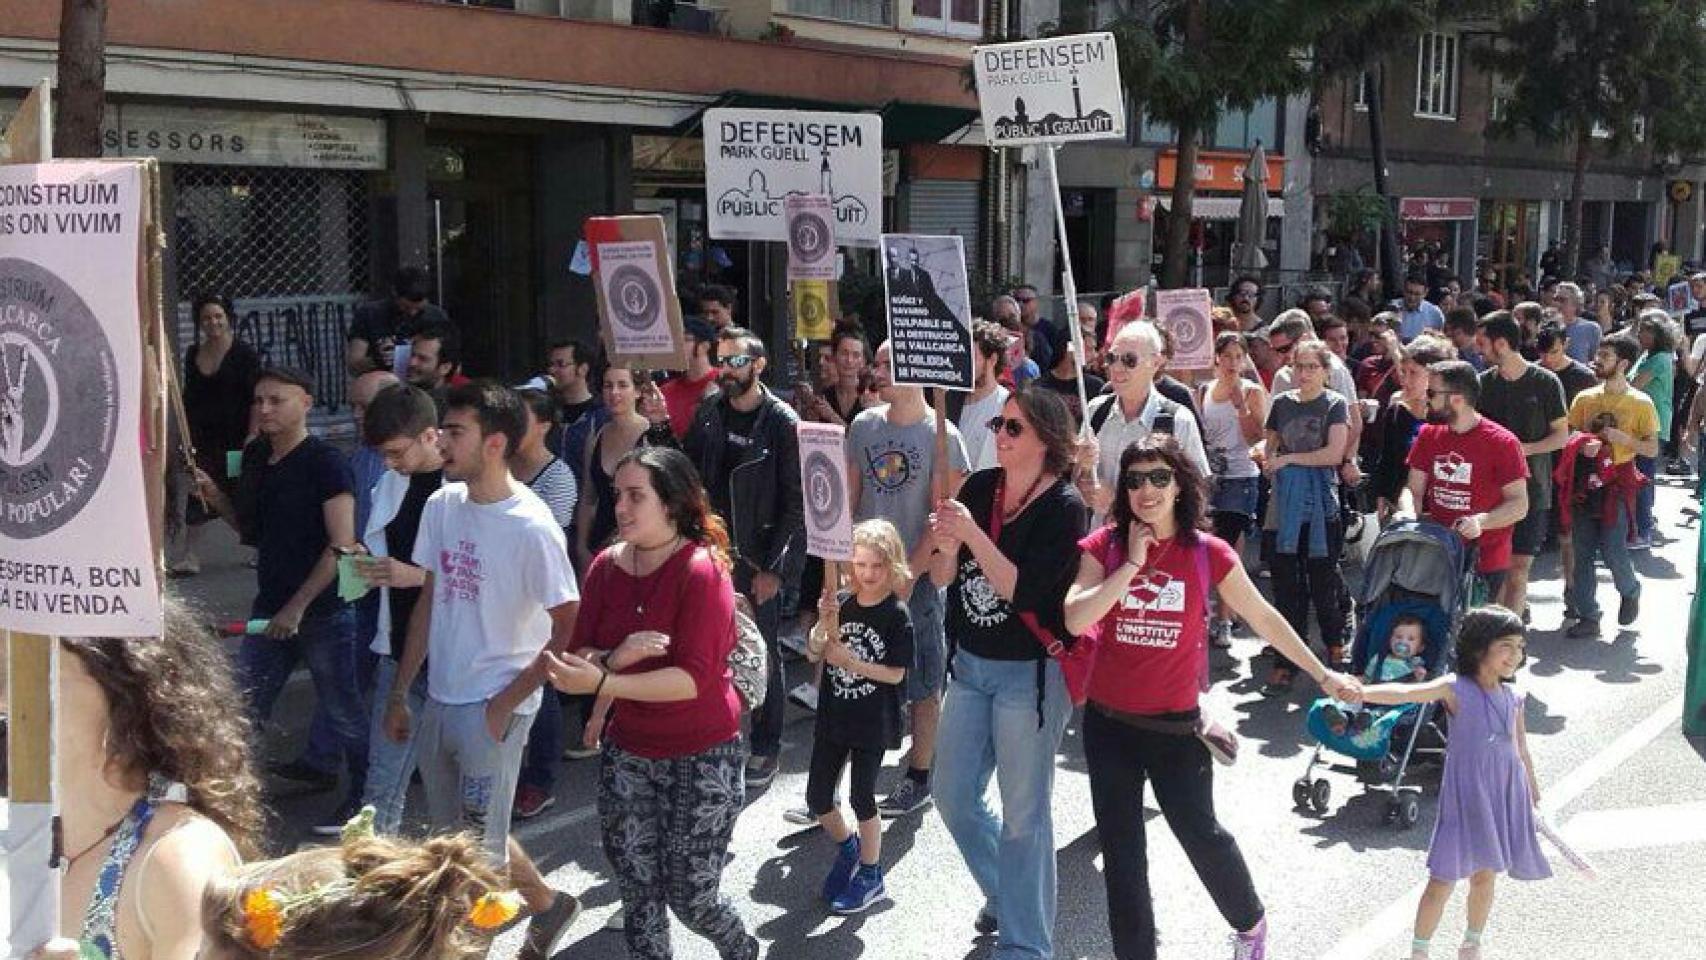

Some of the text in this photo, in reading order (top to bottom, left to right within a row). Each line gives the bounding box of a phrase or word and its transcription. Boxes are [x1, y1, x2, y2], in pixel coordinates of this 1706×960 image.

[984, 41, 1105, 72] DEFENSEM
[720, 121, 862, 148] DEFENSEM
[720, 145, 758, 160] PARK
[19, 213, 49, 234] ON
[56, 212, 121, 234] VIVIM
[893, 317, 940, 328] CULPABLE
[908, 341, 966, 352] VALLCARCA
[88, 566, 142, 588] BCN
[16, 589, 39, 612] EN
[43, 592, 129, 616] VENDA
